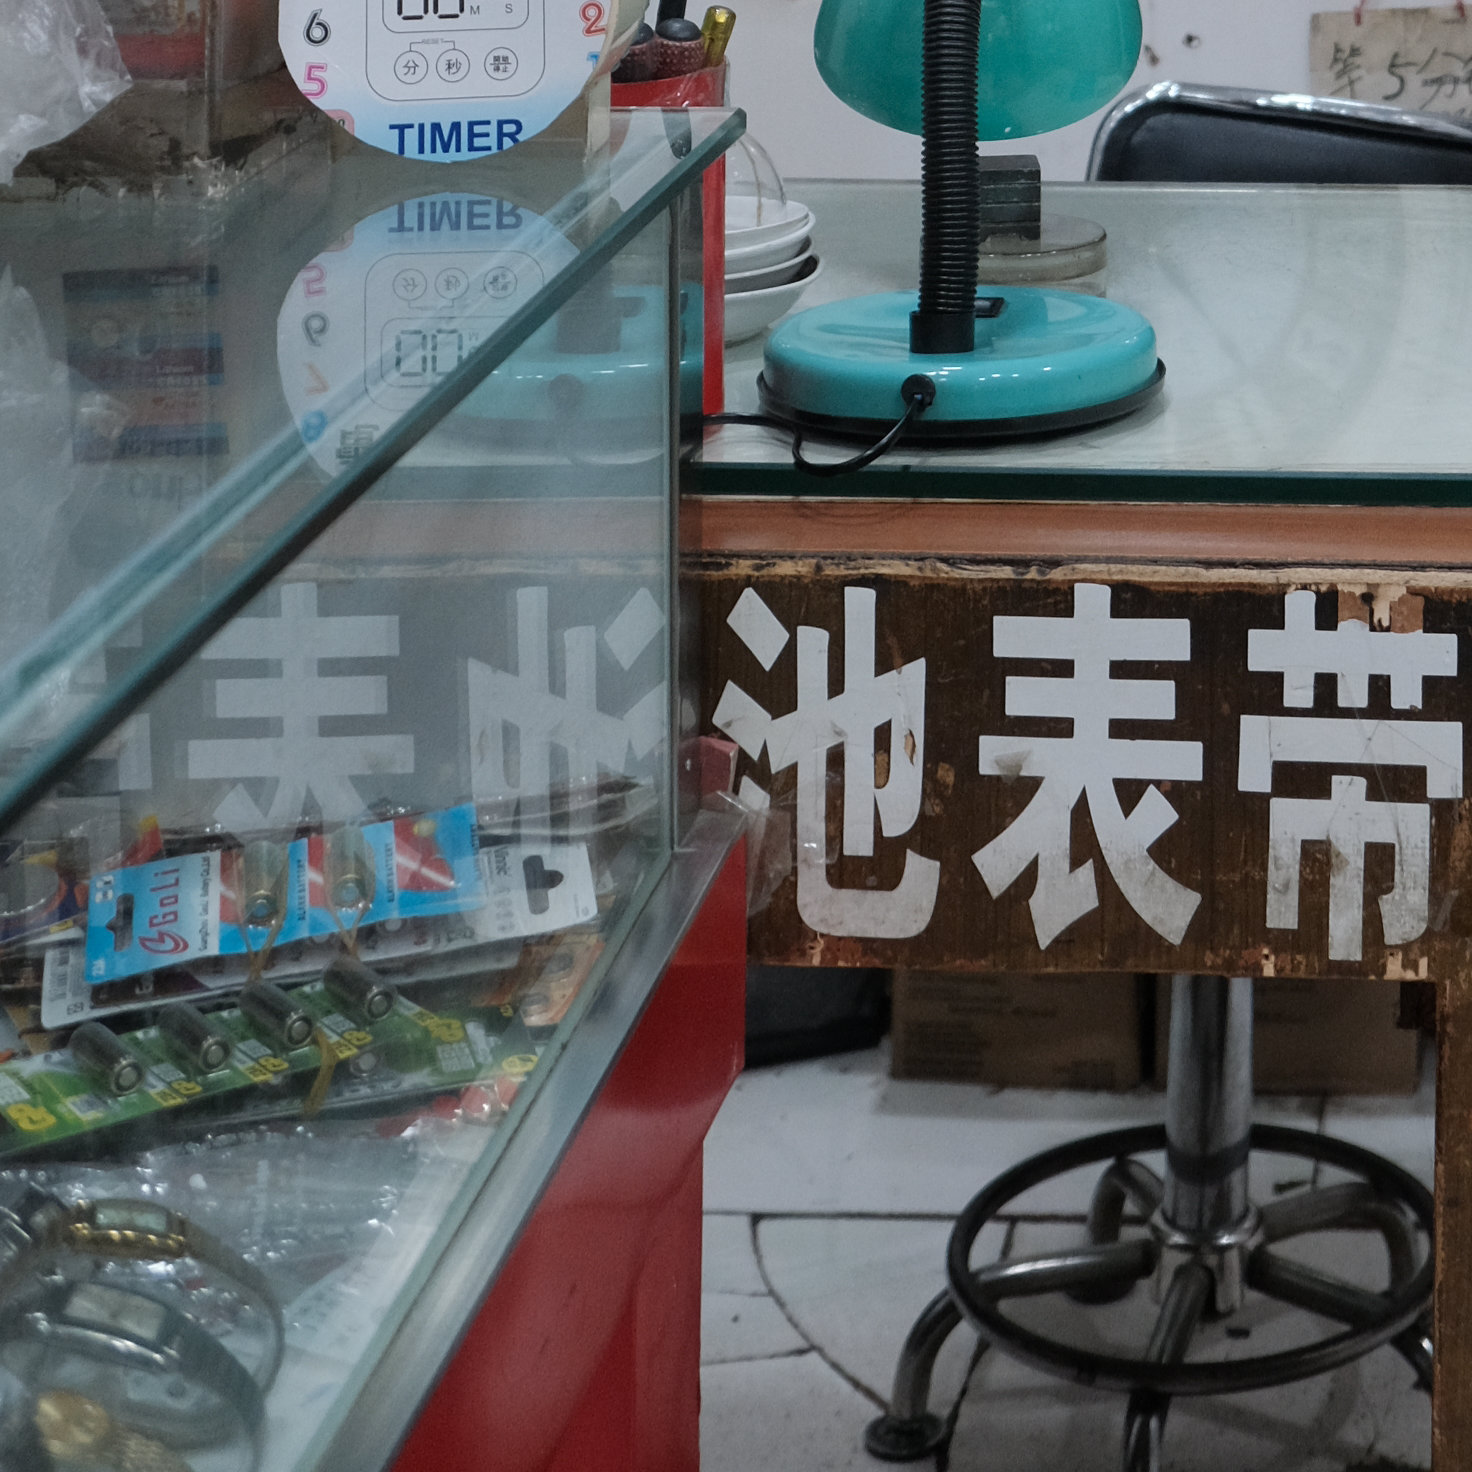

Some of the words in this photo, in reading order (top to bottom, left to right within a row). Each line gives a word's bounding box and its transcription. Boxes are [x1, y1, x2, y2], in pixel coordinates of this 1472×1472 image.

[303, 9, 331, 47] 6
[301, 62, 329, 99] 5
[402, 59, 420, 76] 分
[445, 58, 462, 76] 秒
[389, 118, 524, 156] TIMER
[713, 582, 1465, 962] 池表带
